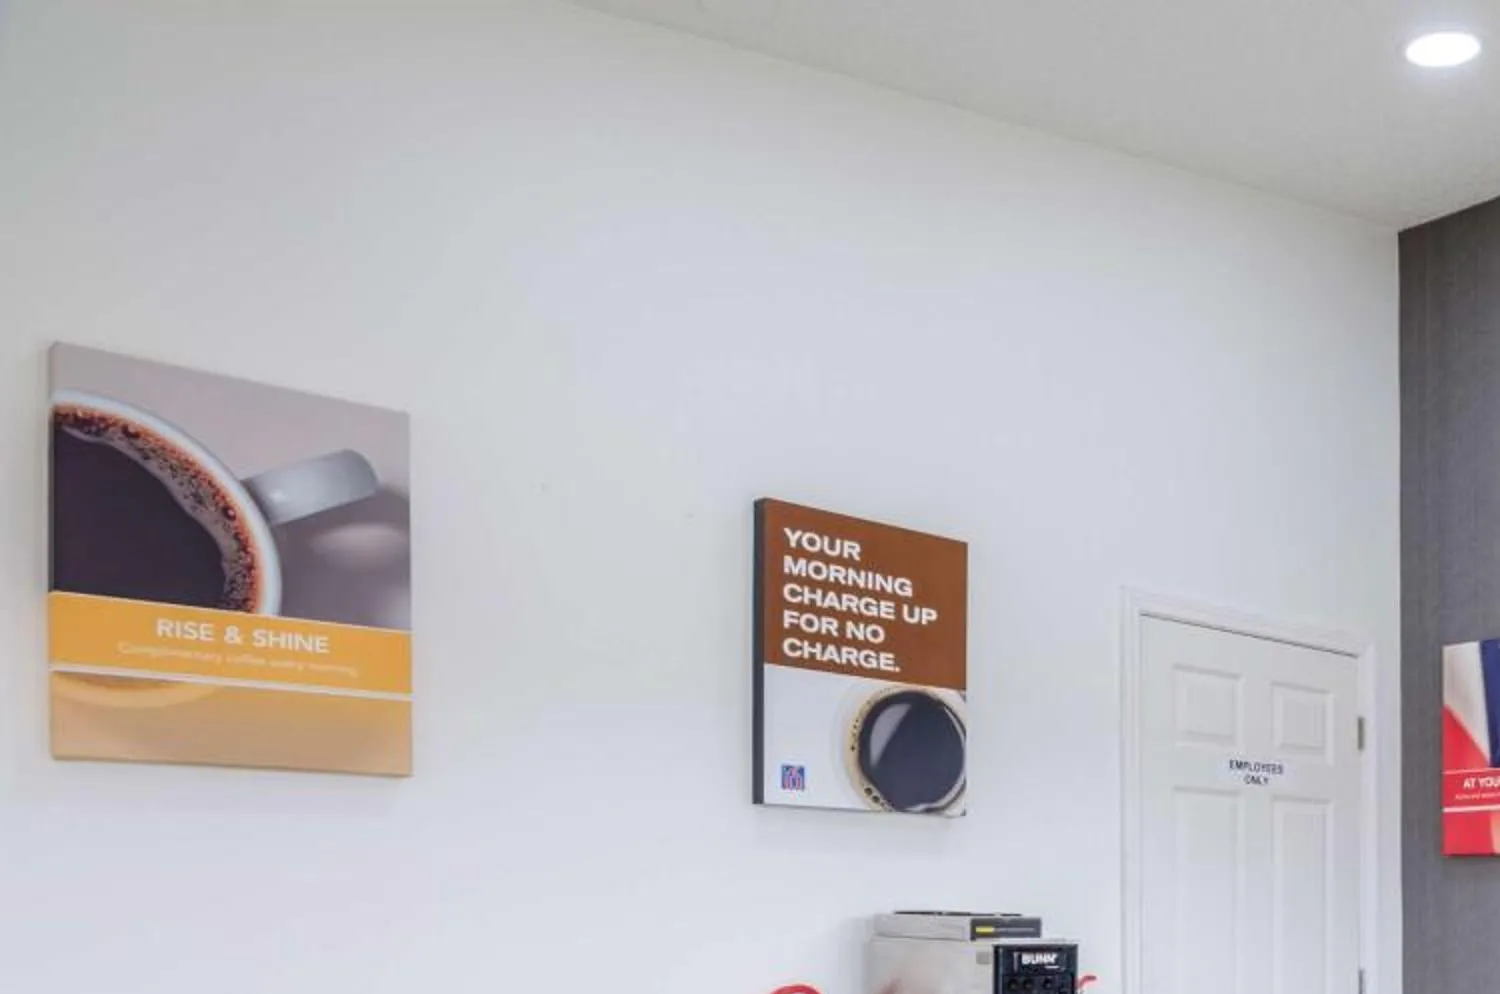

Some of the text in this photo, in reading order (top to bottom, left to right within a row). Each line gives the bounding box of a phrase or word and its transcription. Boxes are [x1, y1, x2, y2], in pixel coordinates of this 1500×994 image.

[783, 527, 861, 561] YOUR
[783, 555, 913, 597] MORNING
[782, 583, 938, 625] CHARGE UP
[157, 618, 329, 654] RISE & SHINE
[783, 610, 885, 644] FOR NO
[782, 637, 900, 672] CHARGE.
[1229, 759, 1284, 775] EMPLOYEES
[1243, 774, 1269, 785] ONLY
[1463, 777, 1476, 789] AT
